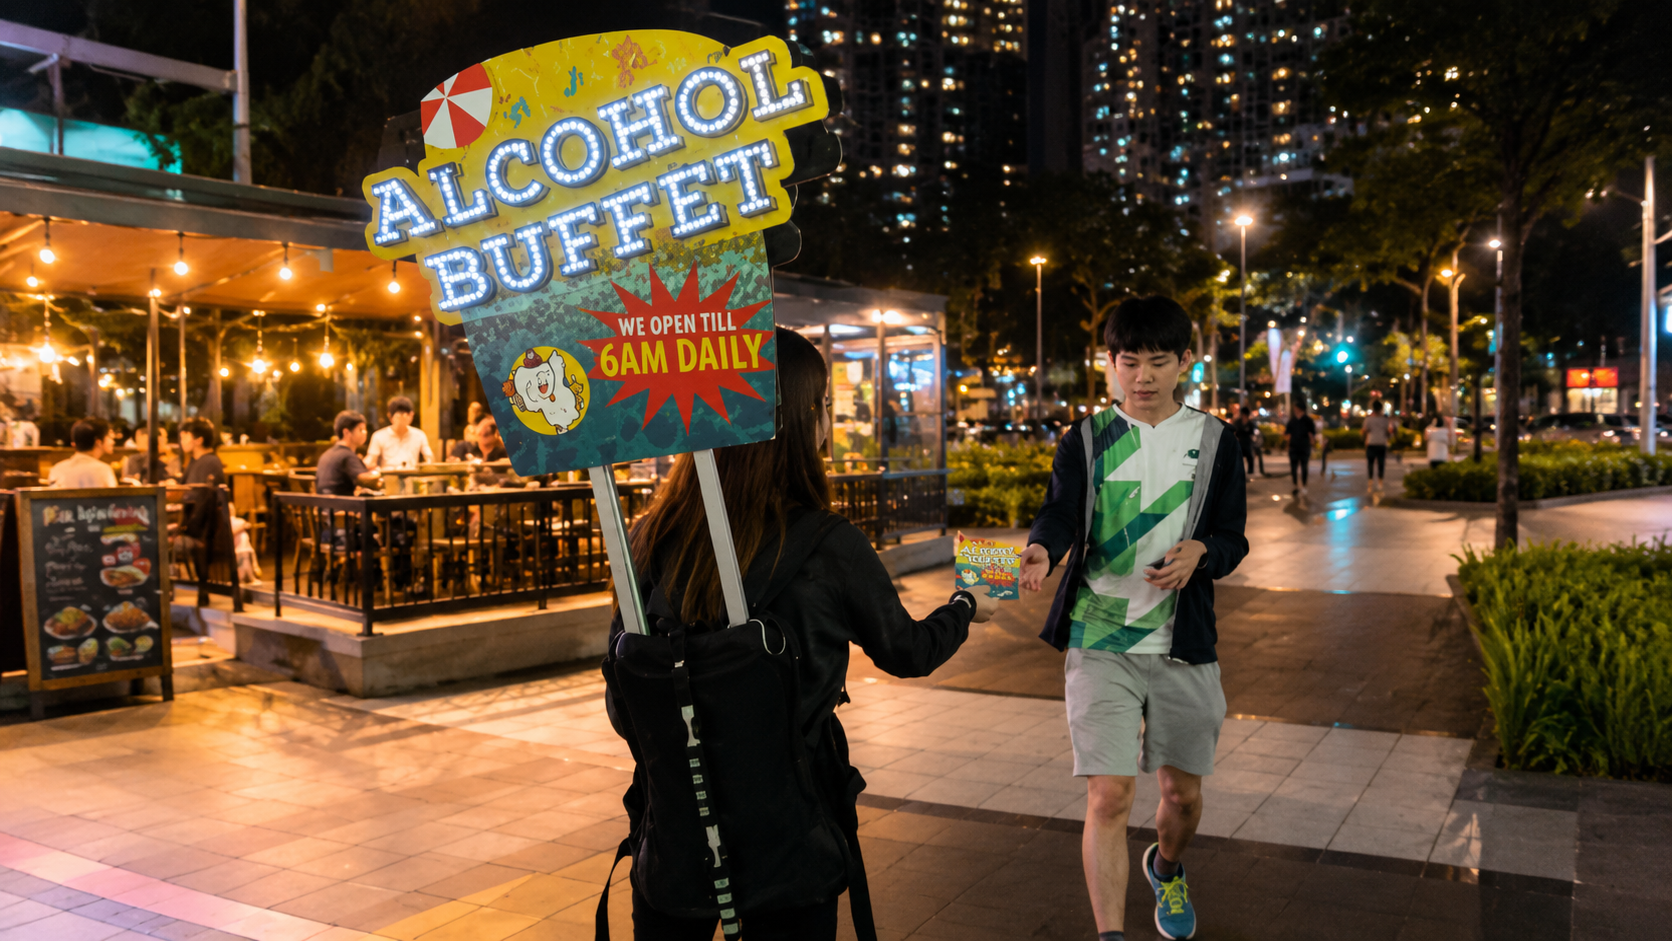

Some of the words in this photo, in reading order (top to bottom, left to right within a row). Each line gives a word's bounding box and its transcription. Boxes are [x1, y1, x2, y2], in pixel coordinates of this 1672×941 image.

[371, 48, 814, 246] ALCOHOL
[424, 138, 779, 312] BUFFET
[600, 339, 669, 378] 6AM
[676, 333, 762, 372] DAILY
[618, 317, 646, 336] WE
[650, 314, 696, 335] OPEN
[700, 312, 737, 333] TILL
